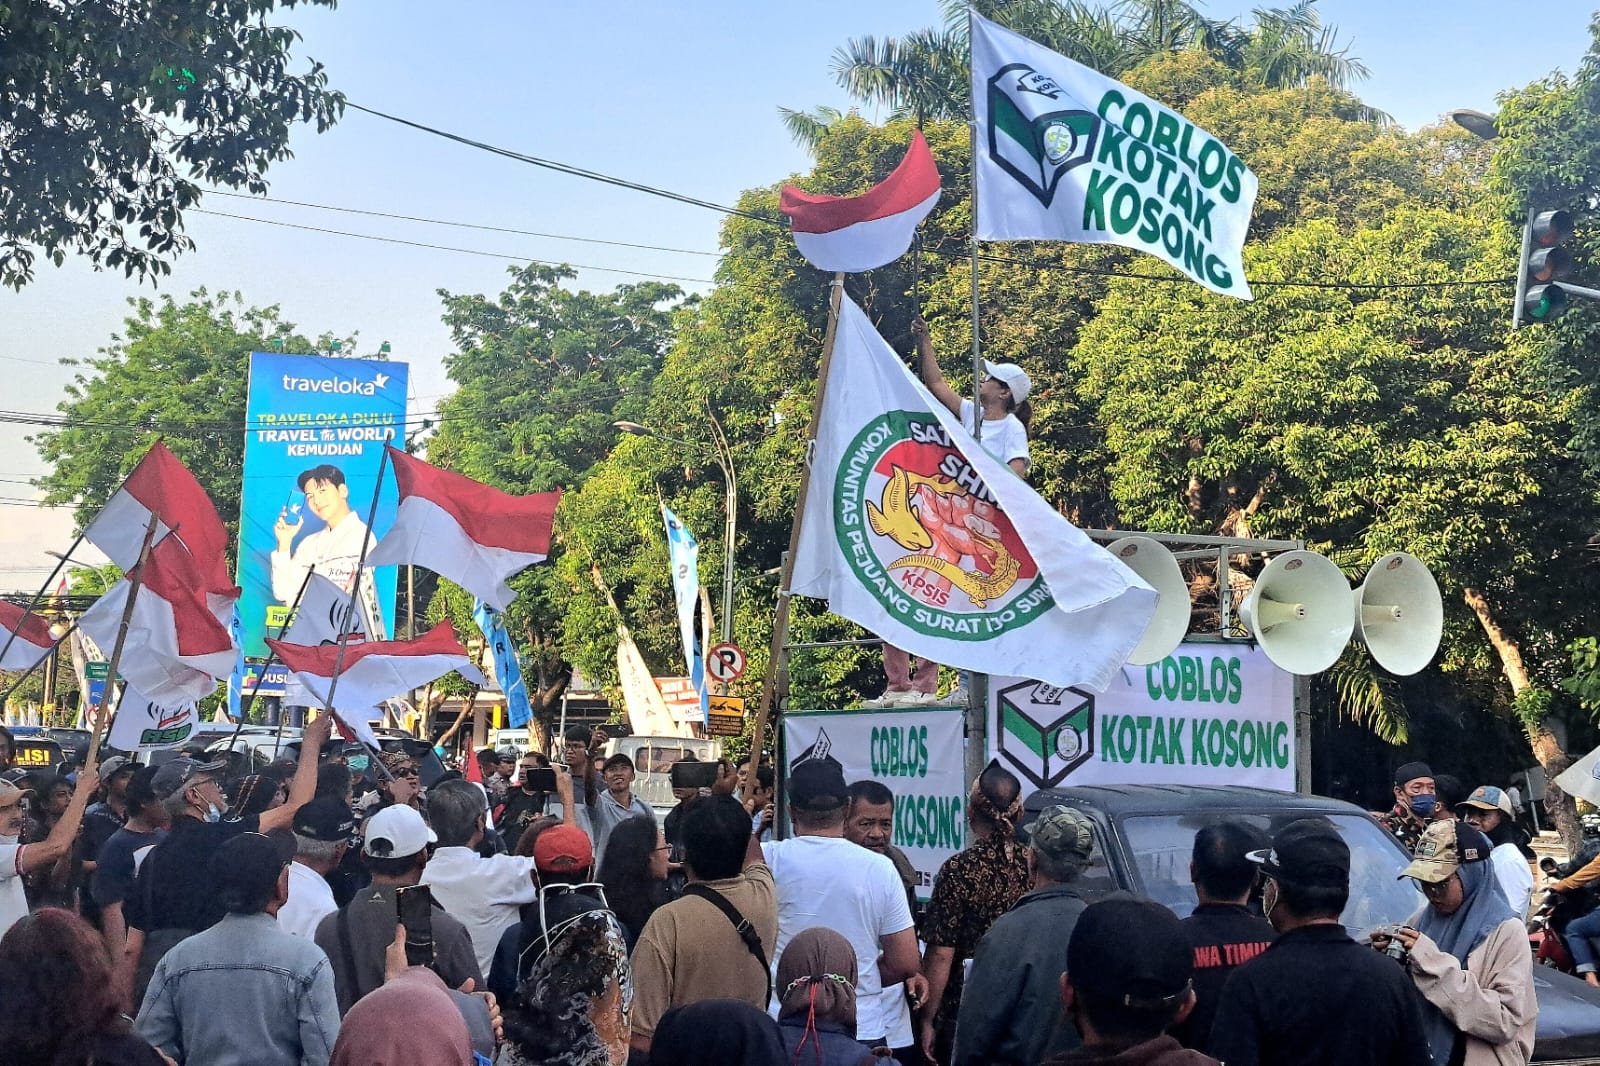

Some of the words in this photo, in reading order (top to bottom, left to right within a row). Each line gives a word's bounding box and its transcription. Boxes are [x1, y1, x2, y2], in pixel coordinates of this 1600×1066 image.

[1097, 90, 1246, 203] COBLOS
[1099, 124, 1216, 242] KOTAK
[1082, 170, 1234, 289] KOSONG
[282, 373, 375, 396] traveloka
[257, 413, 349, 426] TRAVELOKA
[257, 429, 319, 442] TRAVEL
[320, 425, 336, 441] the
[337, 427, 396, 441] WORLD
[287, 443, 363, 456] KEMUDIAN
[840, 422, 893, 527] KOMUNITAS
[846, 531, 911, 614] PEJUANG
[901, 569, 950, 606] KPSIS
[912, 609, 980, 634] SURAT
[985, 609, 1016, 633] IJO
[1146, 656, 1242, 704] COBLOS
[871, 725, 928, 778] COBLOS
[1101, 714, 1185, 764] KOTAK
[1192, 718, 1289, 769] KOSONG
[894, 794, 961, 851] KOSONG
